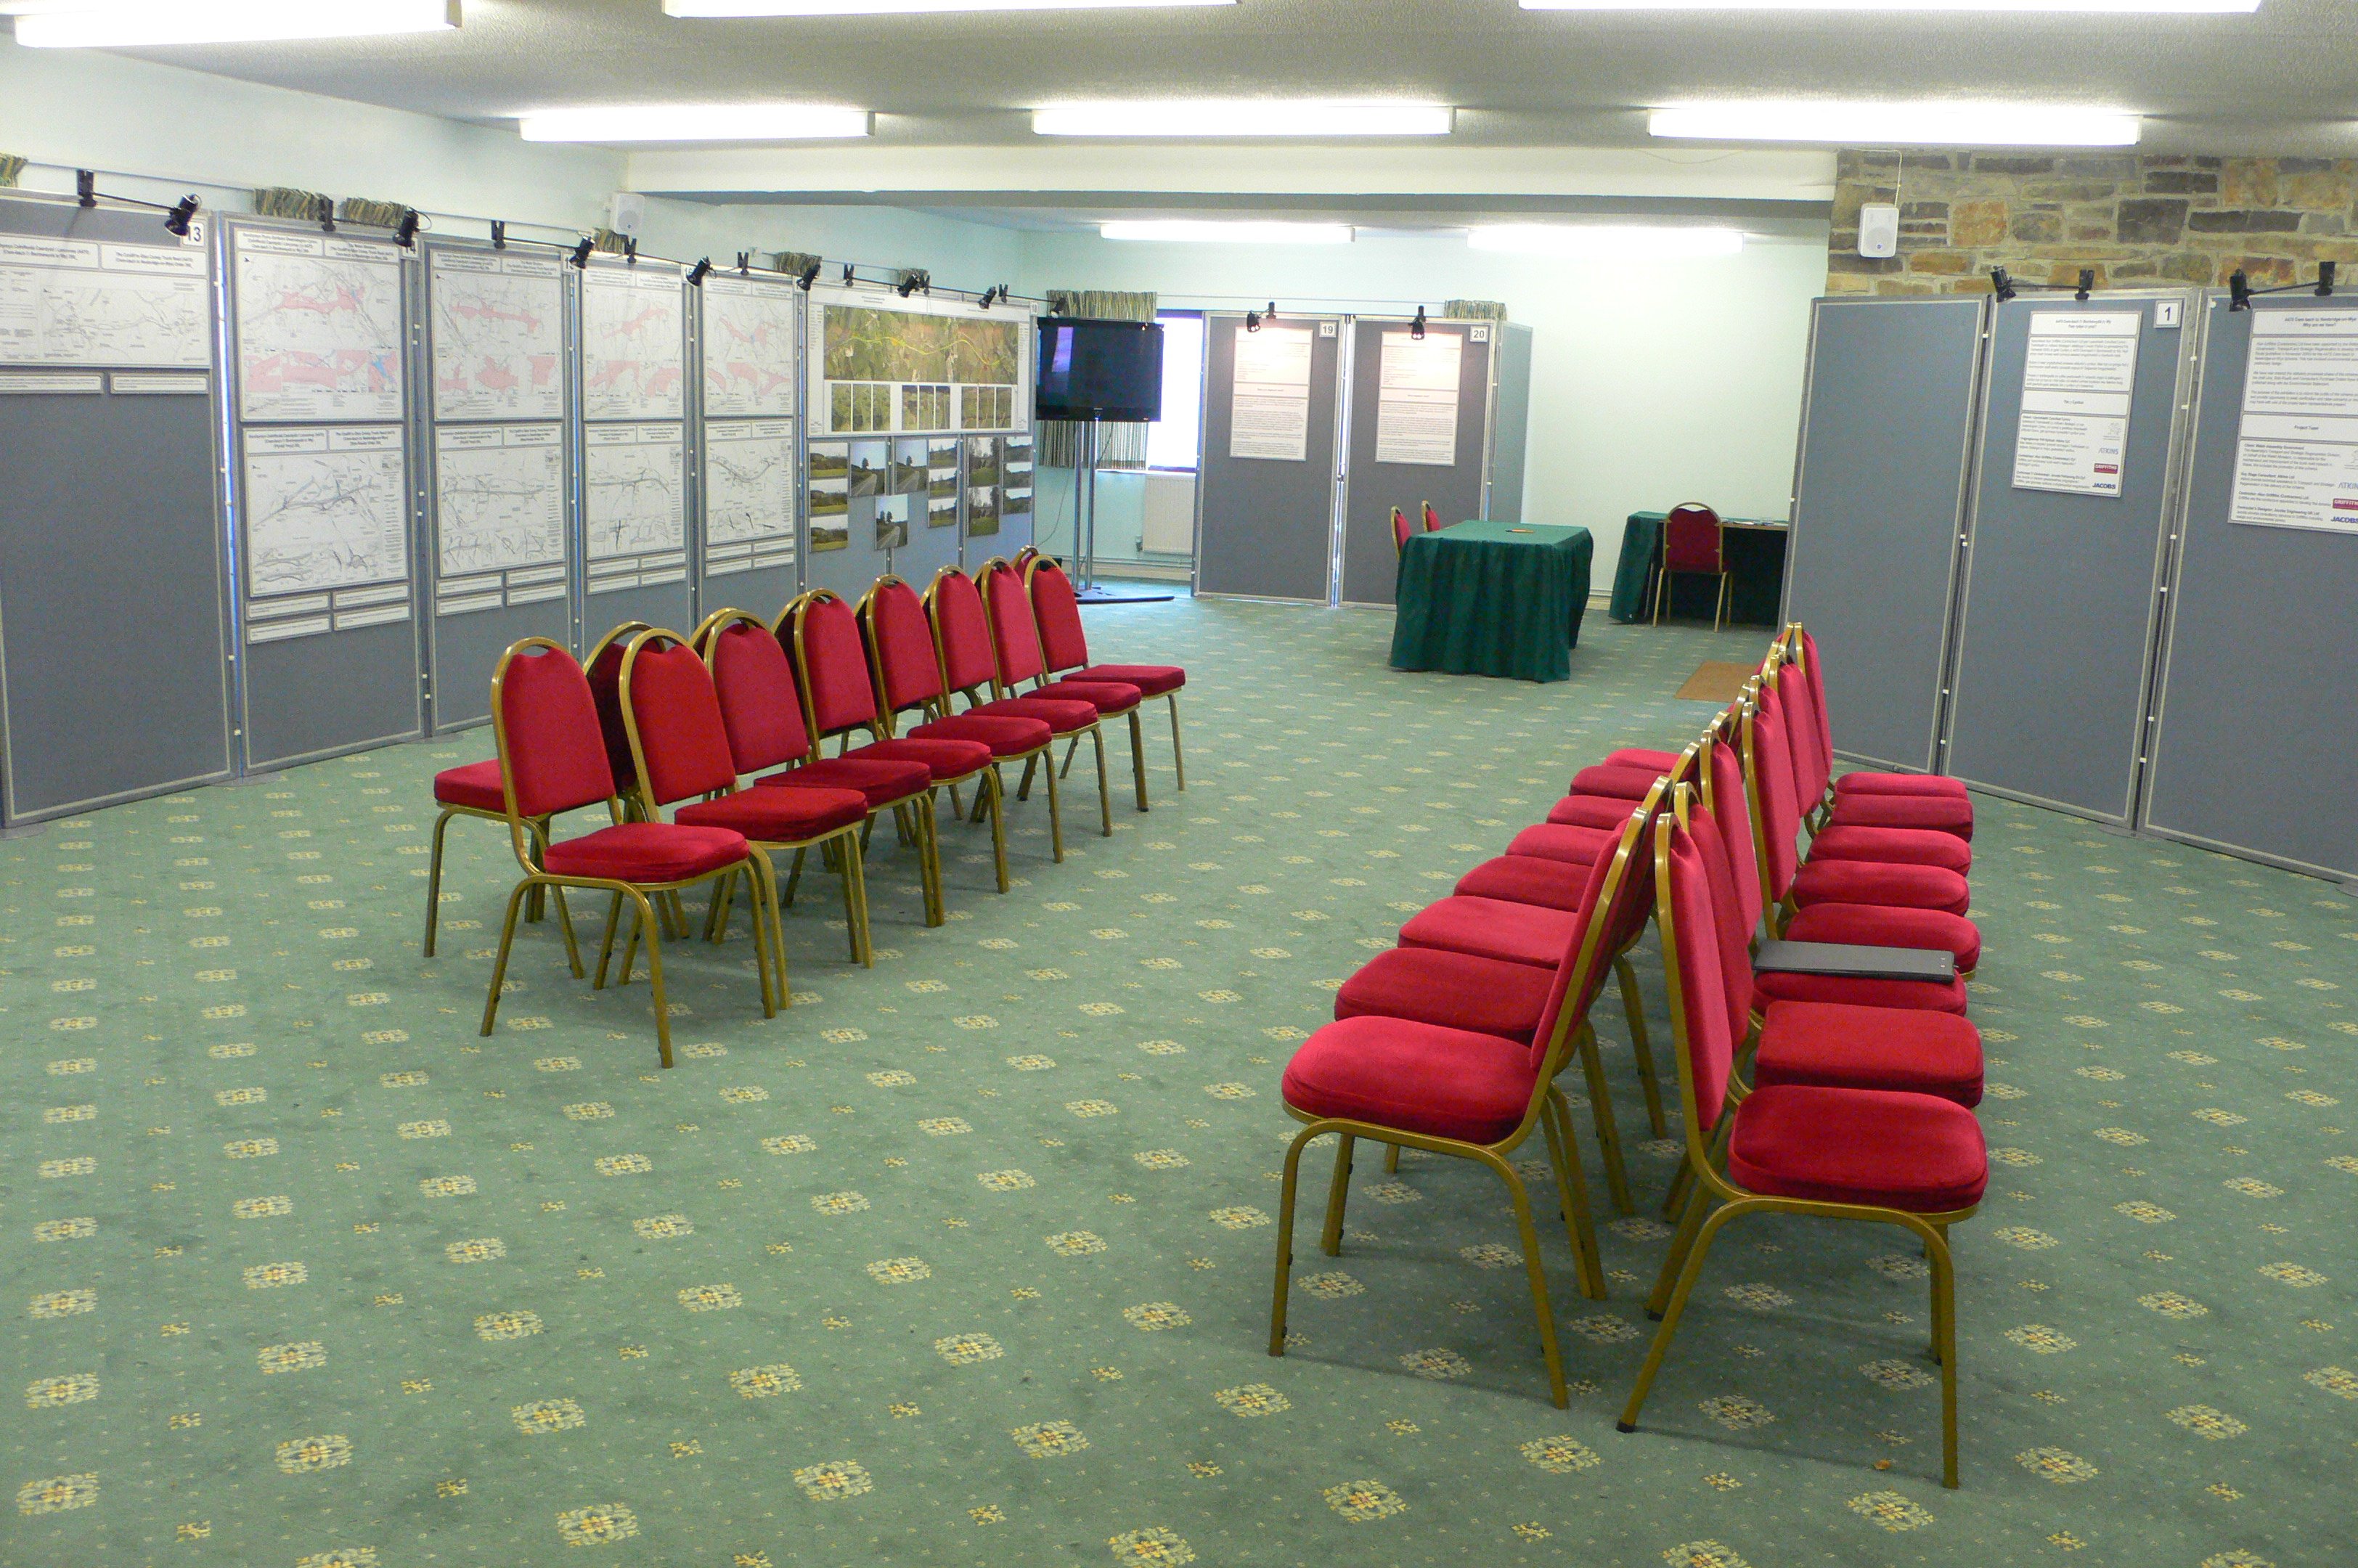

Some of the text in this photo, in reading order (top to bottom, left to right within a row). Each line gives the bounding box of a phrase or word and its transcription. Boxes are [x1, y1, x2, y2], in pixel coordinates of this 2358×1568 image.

[187, 225, 201, 242] 13
[2164, 306, 2171, 321] 1
[1474, 330, 1485, 338] 20
